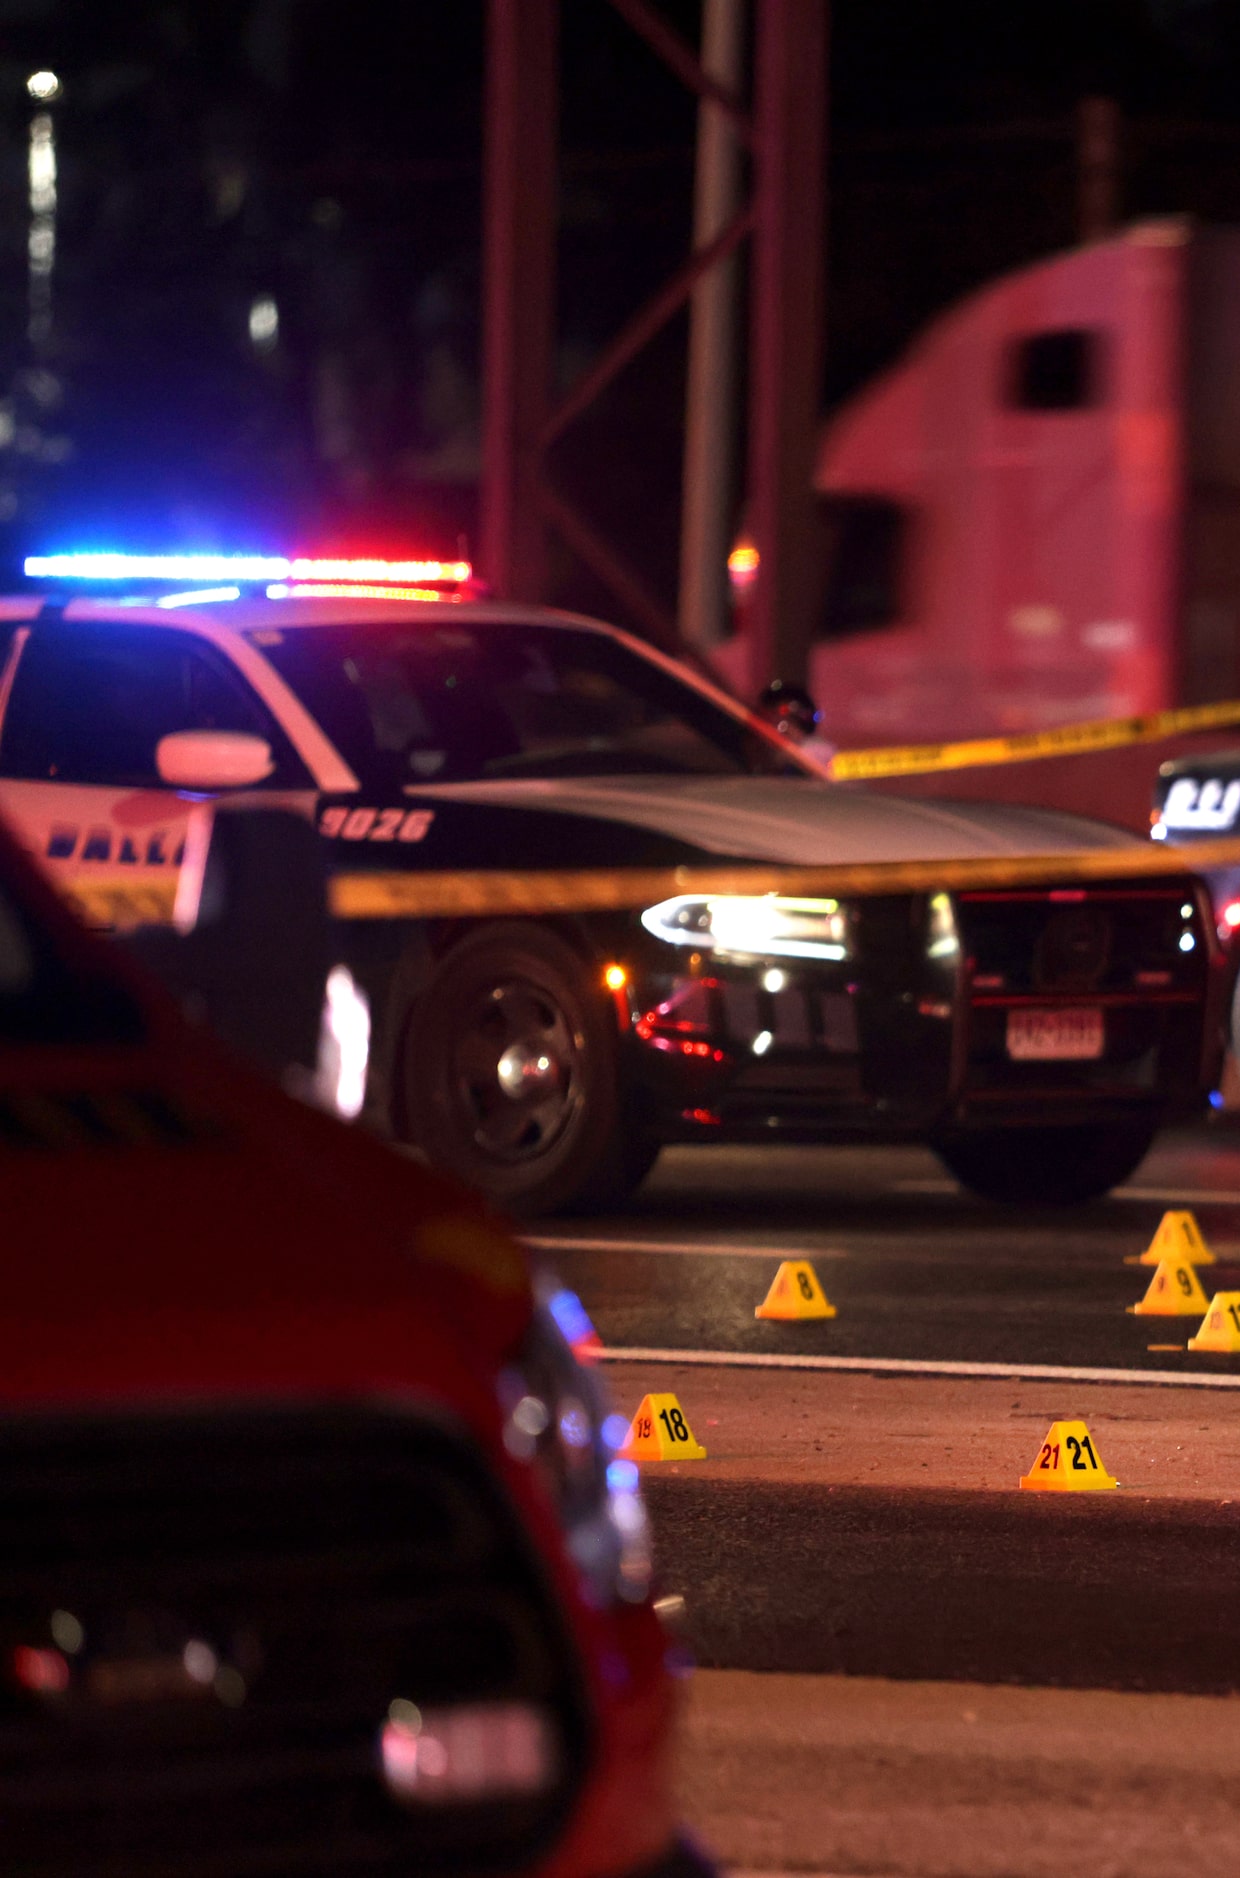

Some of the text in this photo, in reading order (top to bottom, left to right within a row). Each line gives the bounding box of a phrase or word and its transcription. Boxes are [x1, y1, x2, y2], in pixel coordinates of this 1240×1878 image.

[318, 806, 436, 843] 9026
[797, 1271, 814, 1302] 8
[1176, 1267, 1194, 1297] 9
[659, 1408, 689, 1442] 18
[1040, 1443, 1060, 1470] 21
[1066, 1435, 1098, 1470] 21
